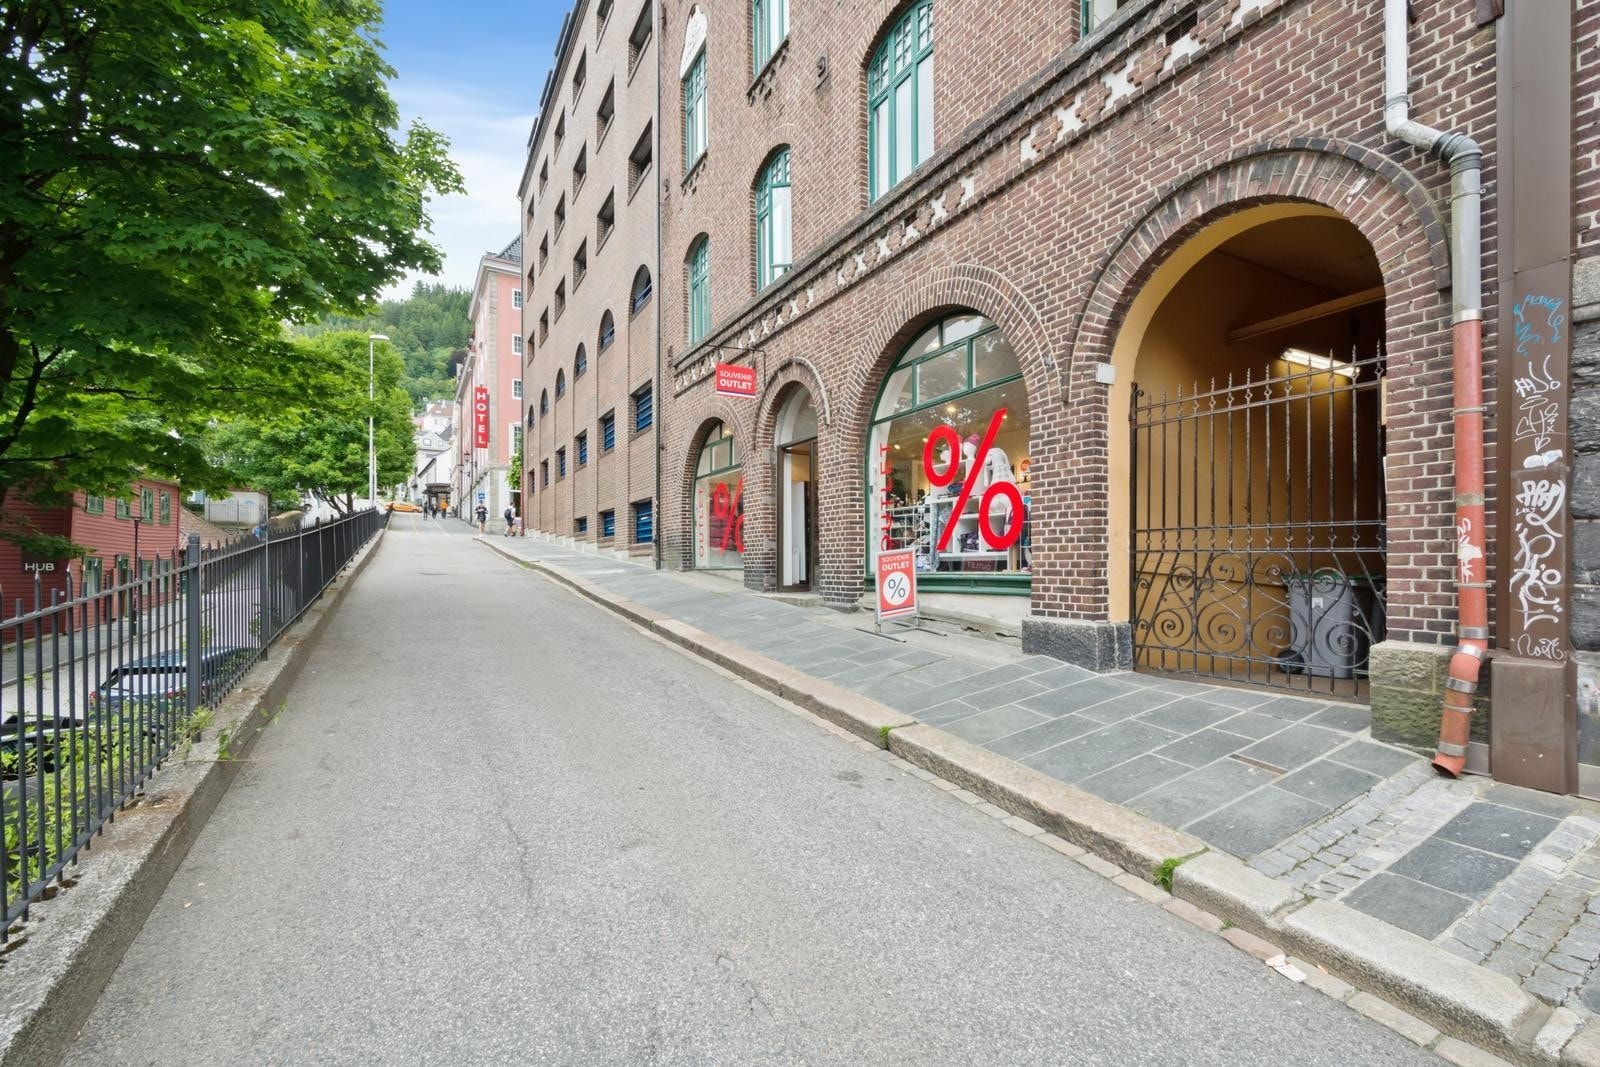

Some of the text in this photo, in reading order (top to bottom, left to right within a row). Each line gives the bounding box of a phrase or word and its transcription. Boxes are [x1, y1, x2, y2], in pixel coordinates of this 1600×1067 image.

[720, 370, 752, 380] SOUVENIR
[720, 379, 752, 390] OUTLET
[477, 392, 486, 444] HOTEL
[881, 553, 910, 563] SOUVENIR
[25, 563, 55, 571] HUB
[881, 561, 910, 571] OUTLET
